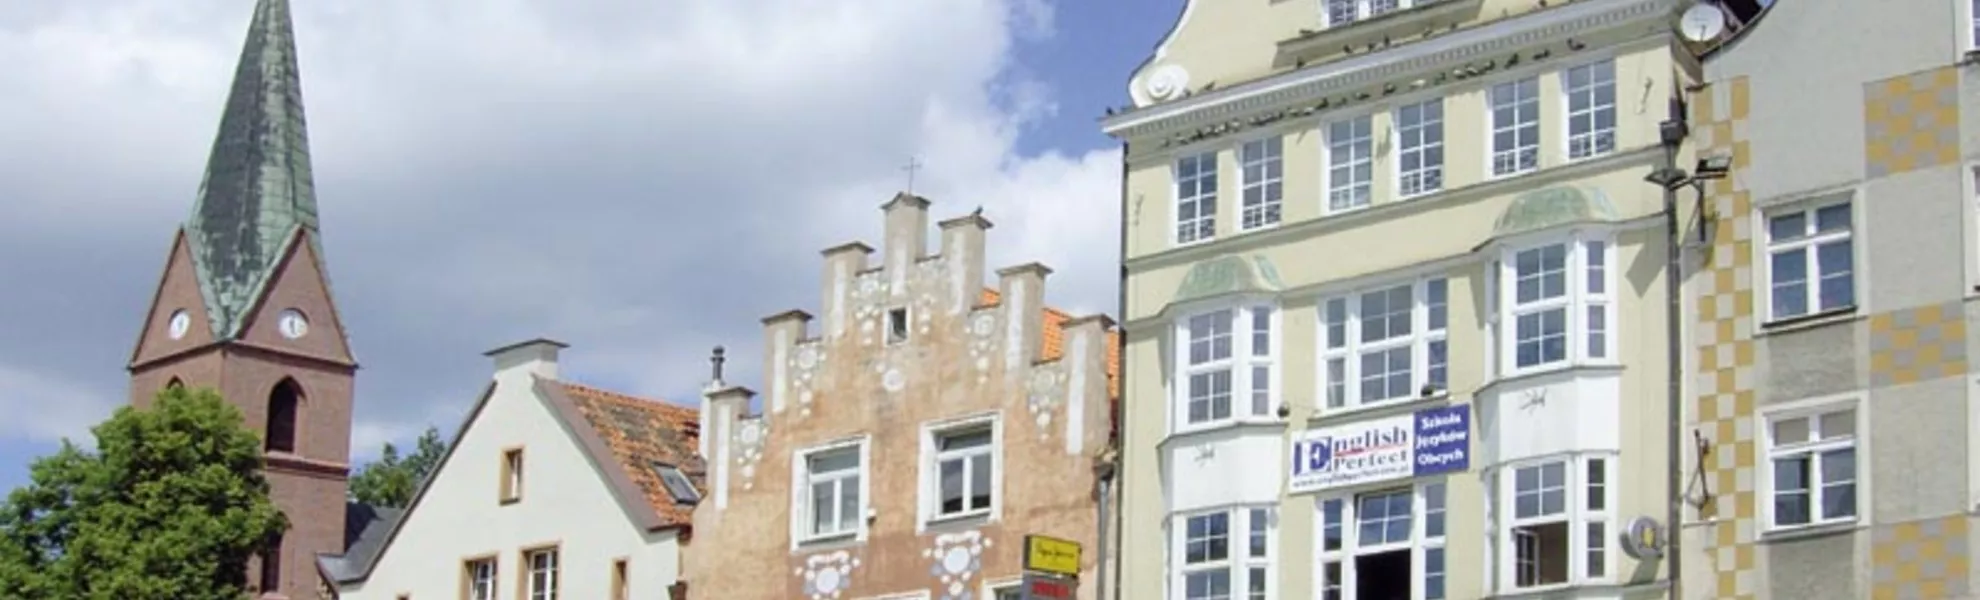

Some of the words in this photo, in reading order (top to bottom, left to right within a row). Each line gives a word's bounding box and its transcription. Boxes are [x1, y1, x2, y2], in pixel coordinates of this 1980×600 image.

[1421, 413, 1461, 430] Szkoła
[1294, 426, 1407, 476] English
[1334, 450, 1407, 471] Perfect
[1418, 448, 1464, 466] Obcych
